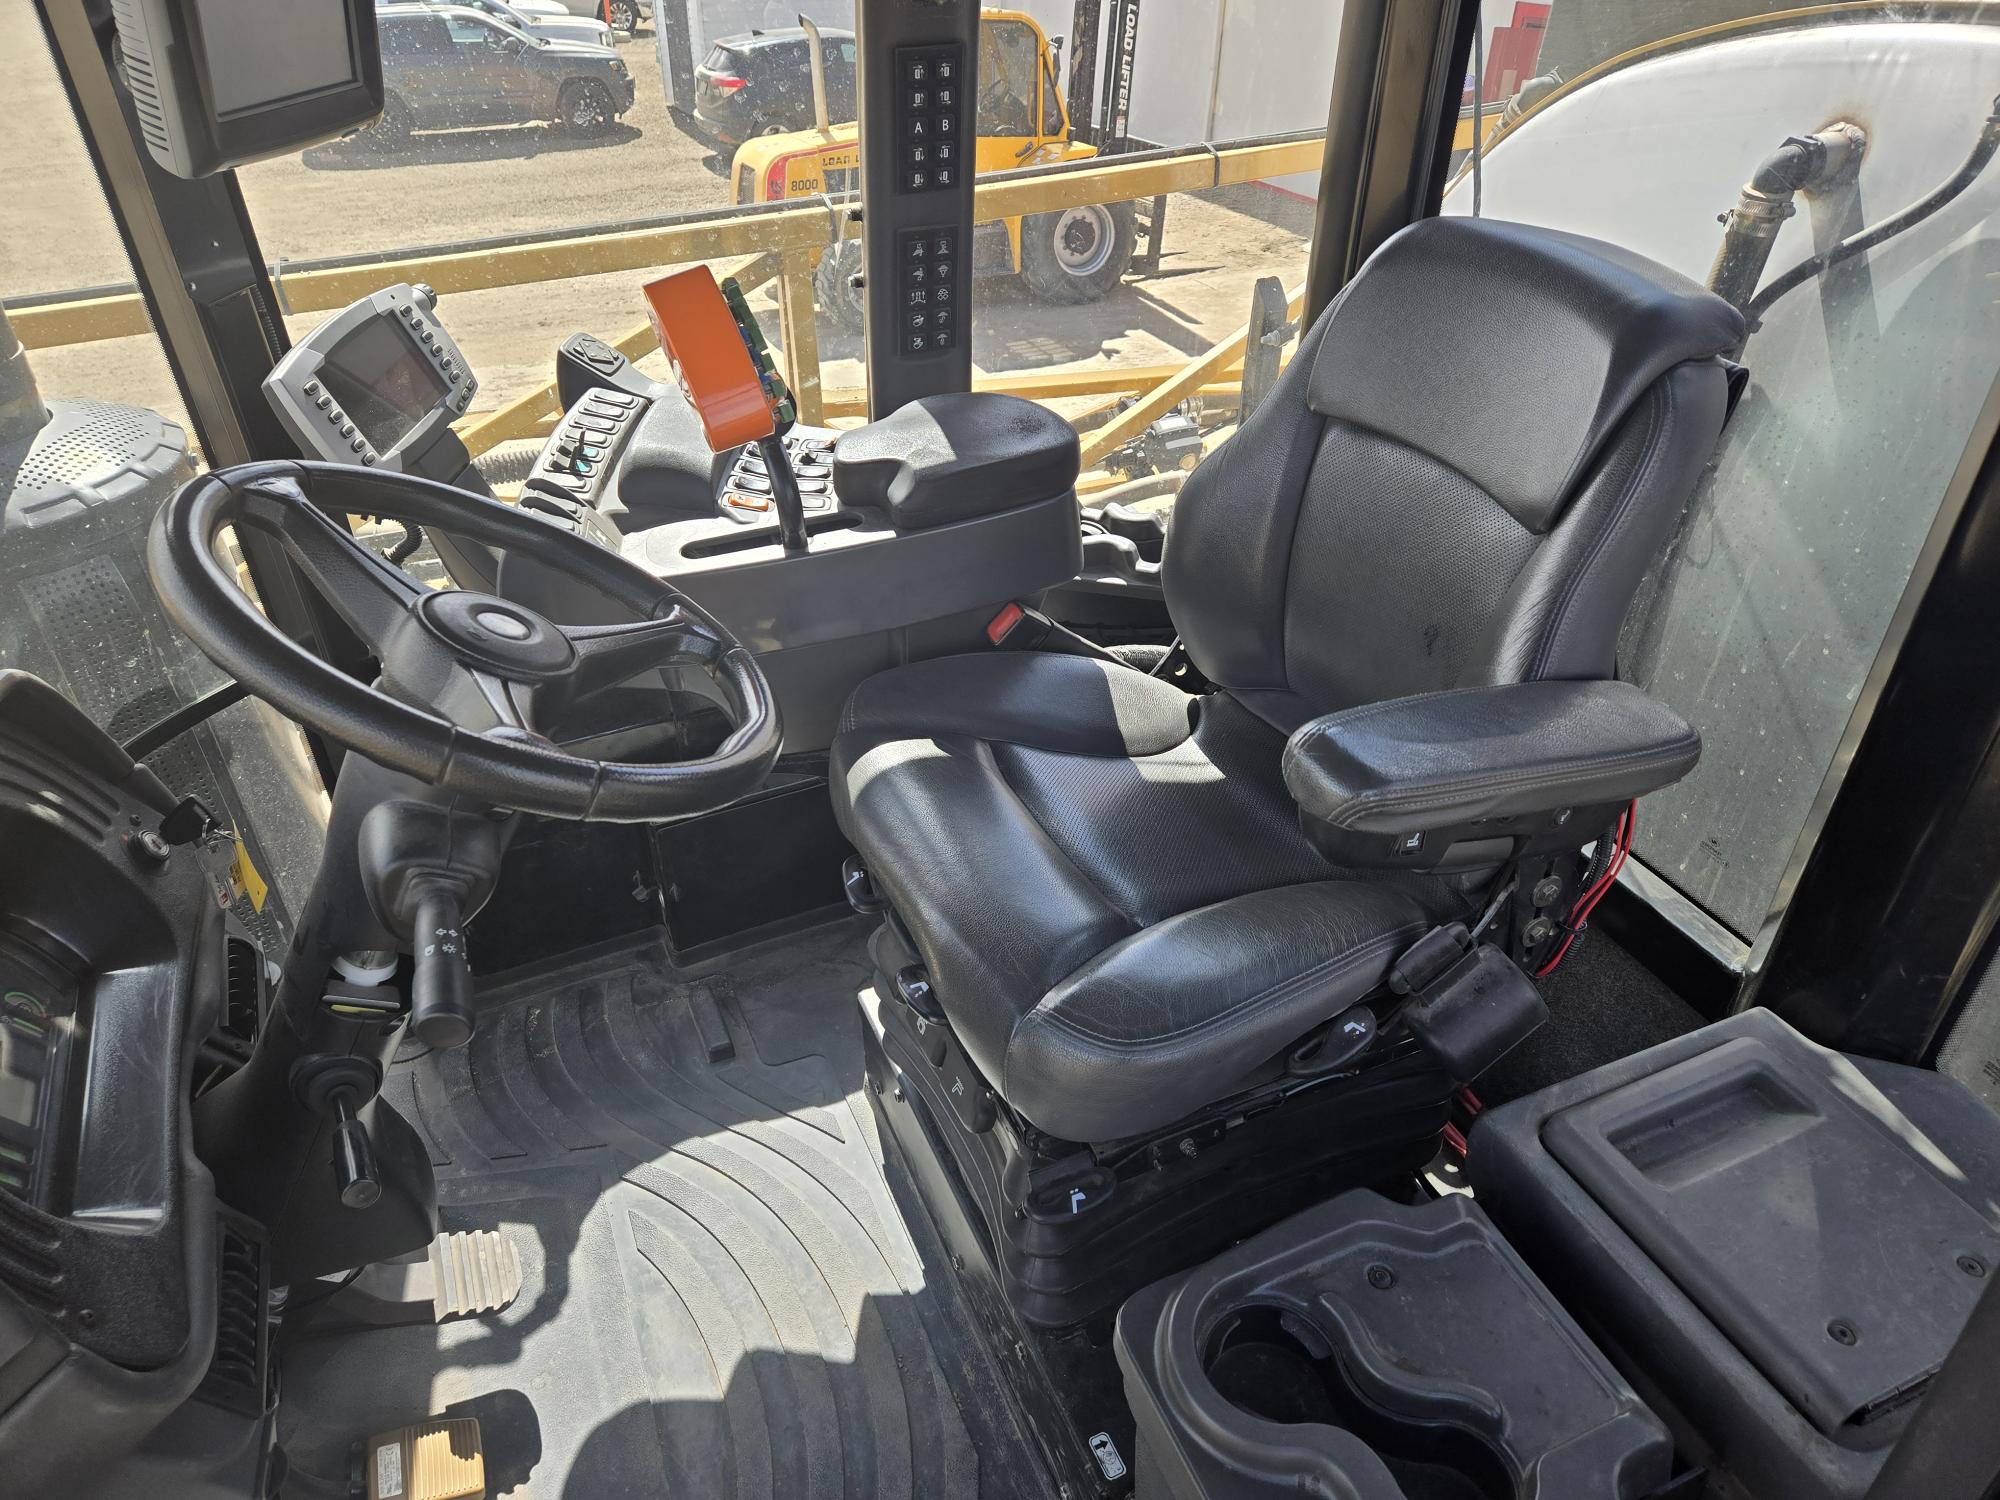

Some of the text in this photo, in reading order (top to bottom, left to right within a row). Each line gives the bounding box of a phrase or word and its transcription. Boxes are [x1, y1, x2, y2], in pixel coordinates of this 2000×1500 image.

[1124, 3, 1137, 50] LOAD
[1118, 54, 1132, 111] LIFTER
[914, 122, 923, 134] A
[942, 119, 949, 131] B
[791, 179, 818, 191] 8000
